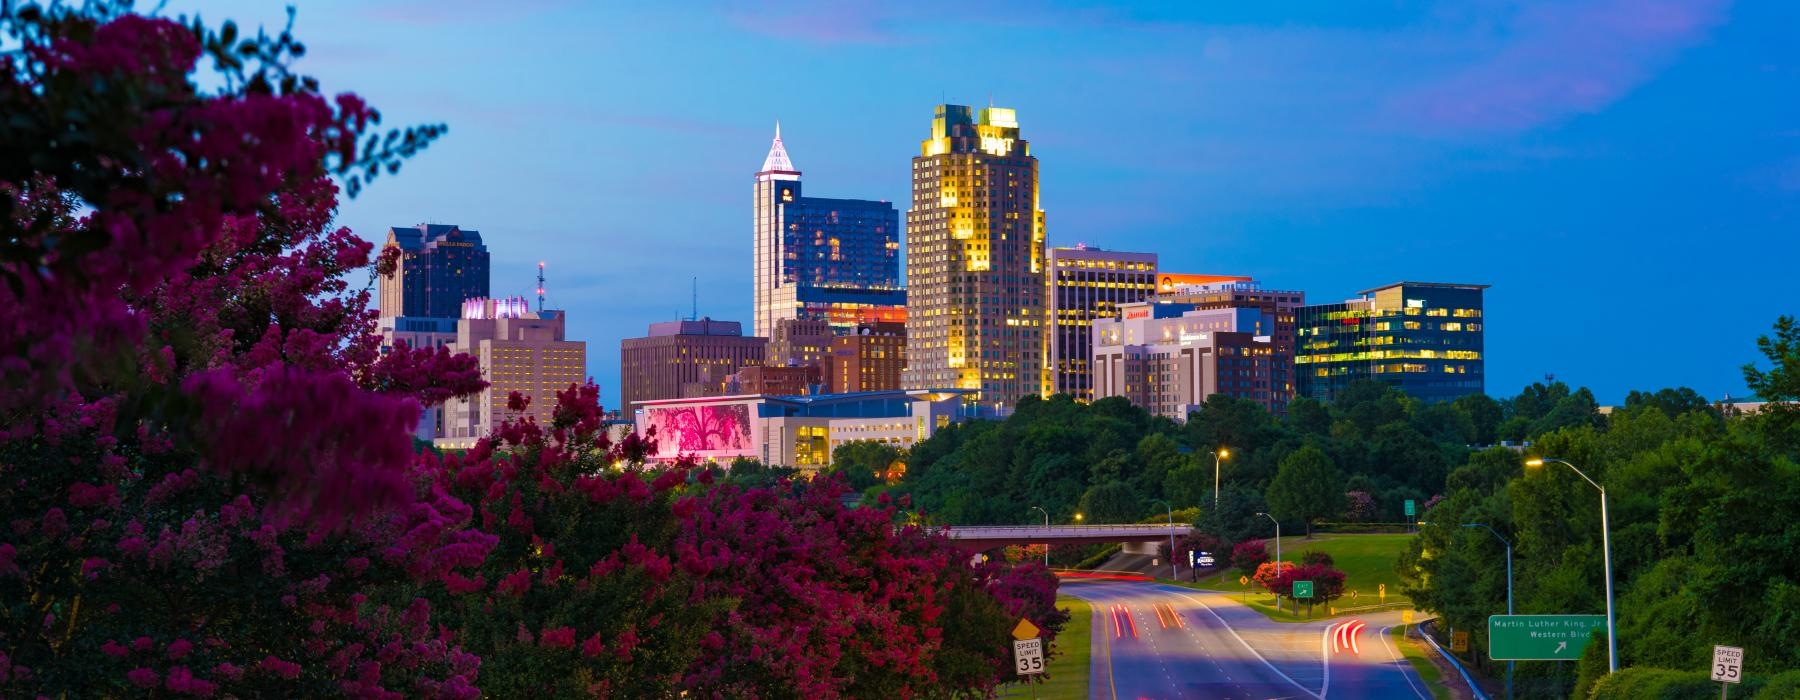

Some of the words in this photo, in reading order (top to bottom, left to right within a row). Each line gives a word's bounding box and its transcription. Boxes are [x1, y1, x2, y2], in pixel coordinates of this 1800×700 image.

[1494, 620, 1525, 628] Martin
[1528, 620, 1559, 628] Luther
[1016, 641, 1040, 650] SPEED
[1716, 649, 1741, 658] SPEED
[1020, 656, 1042, 671] 35
[1716, 663, 1738, 678] 35
